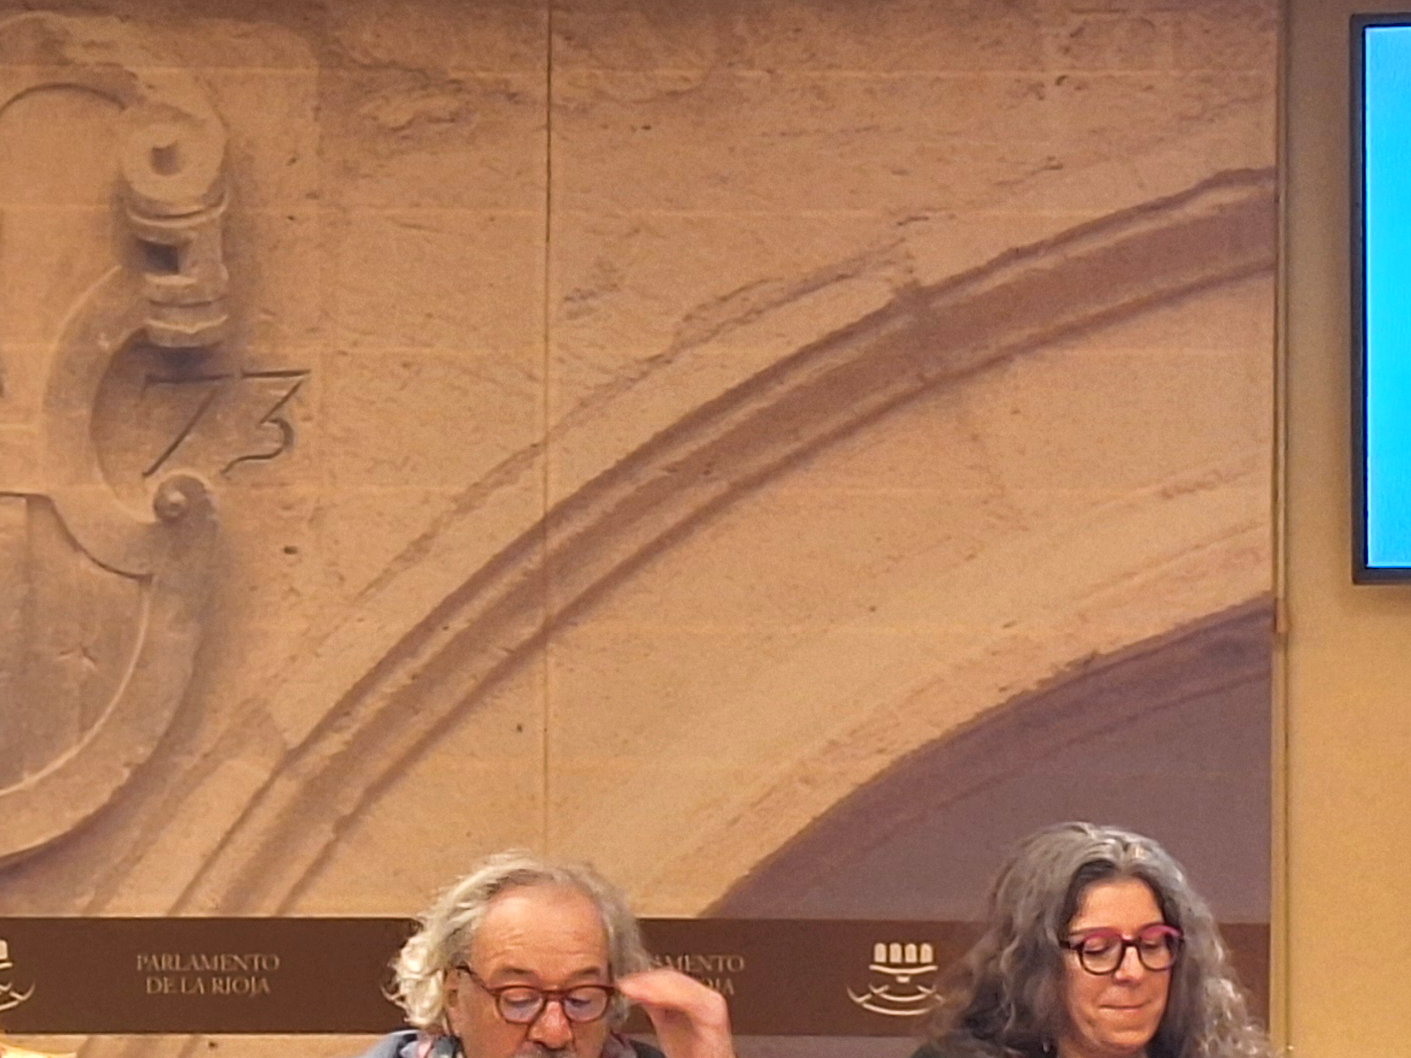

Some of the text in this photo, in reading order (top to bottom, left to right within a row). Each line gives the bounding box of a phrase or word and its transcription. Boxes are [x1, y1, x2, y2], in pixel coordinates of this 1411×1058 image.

[140, 368, 312, 478] 73
[137, 953, 280, 971] PARLAMENTO
[147, 975, 270, 997] DE LA RIOJA
